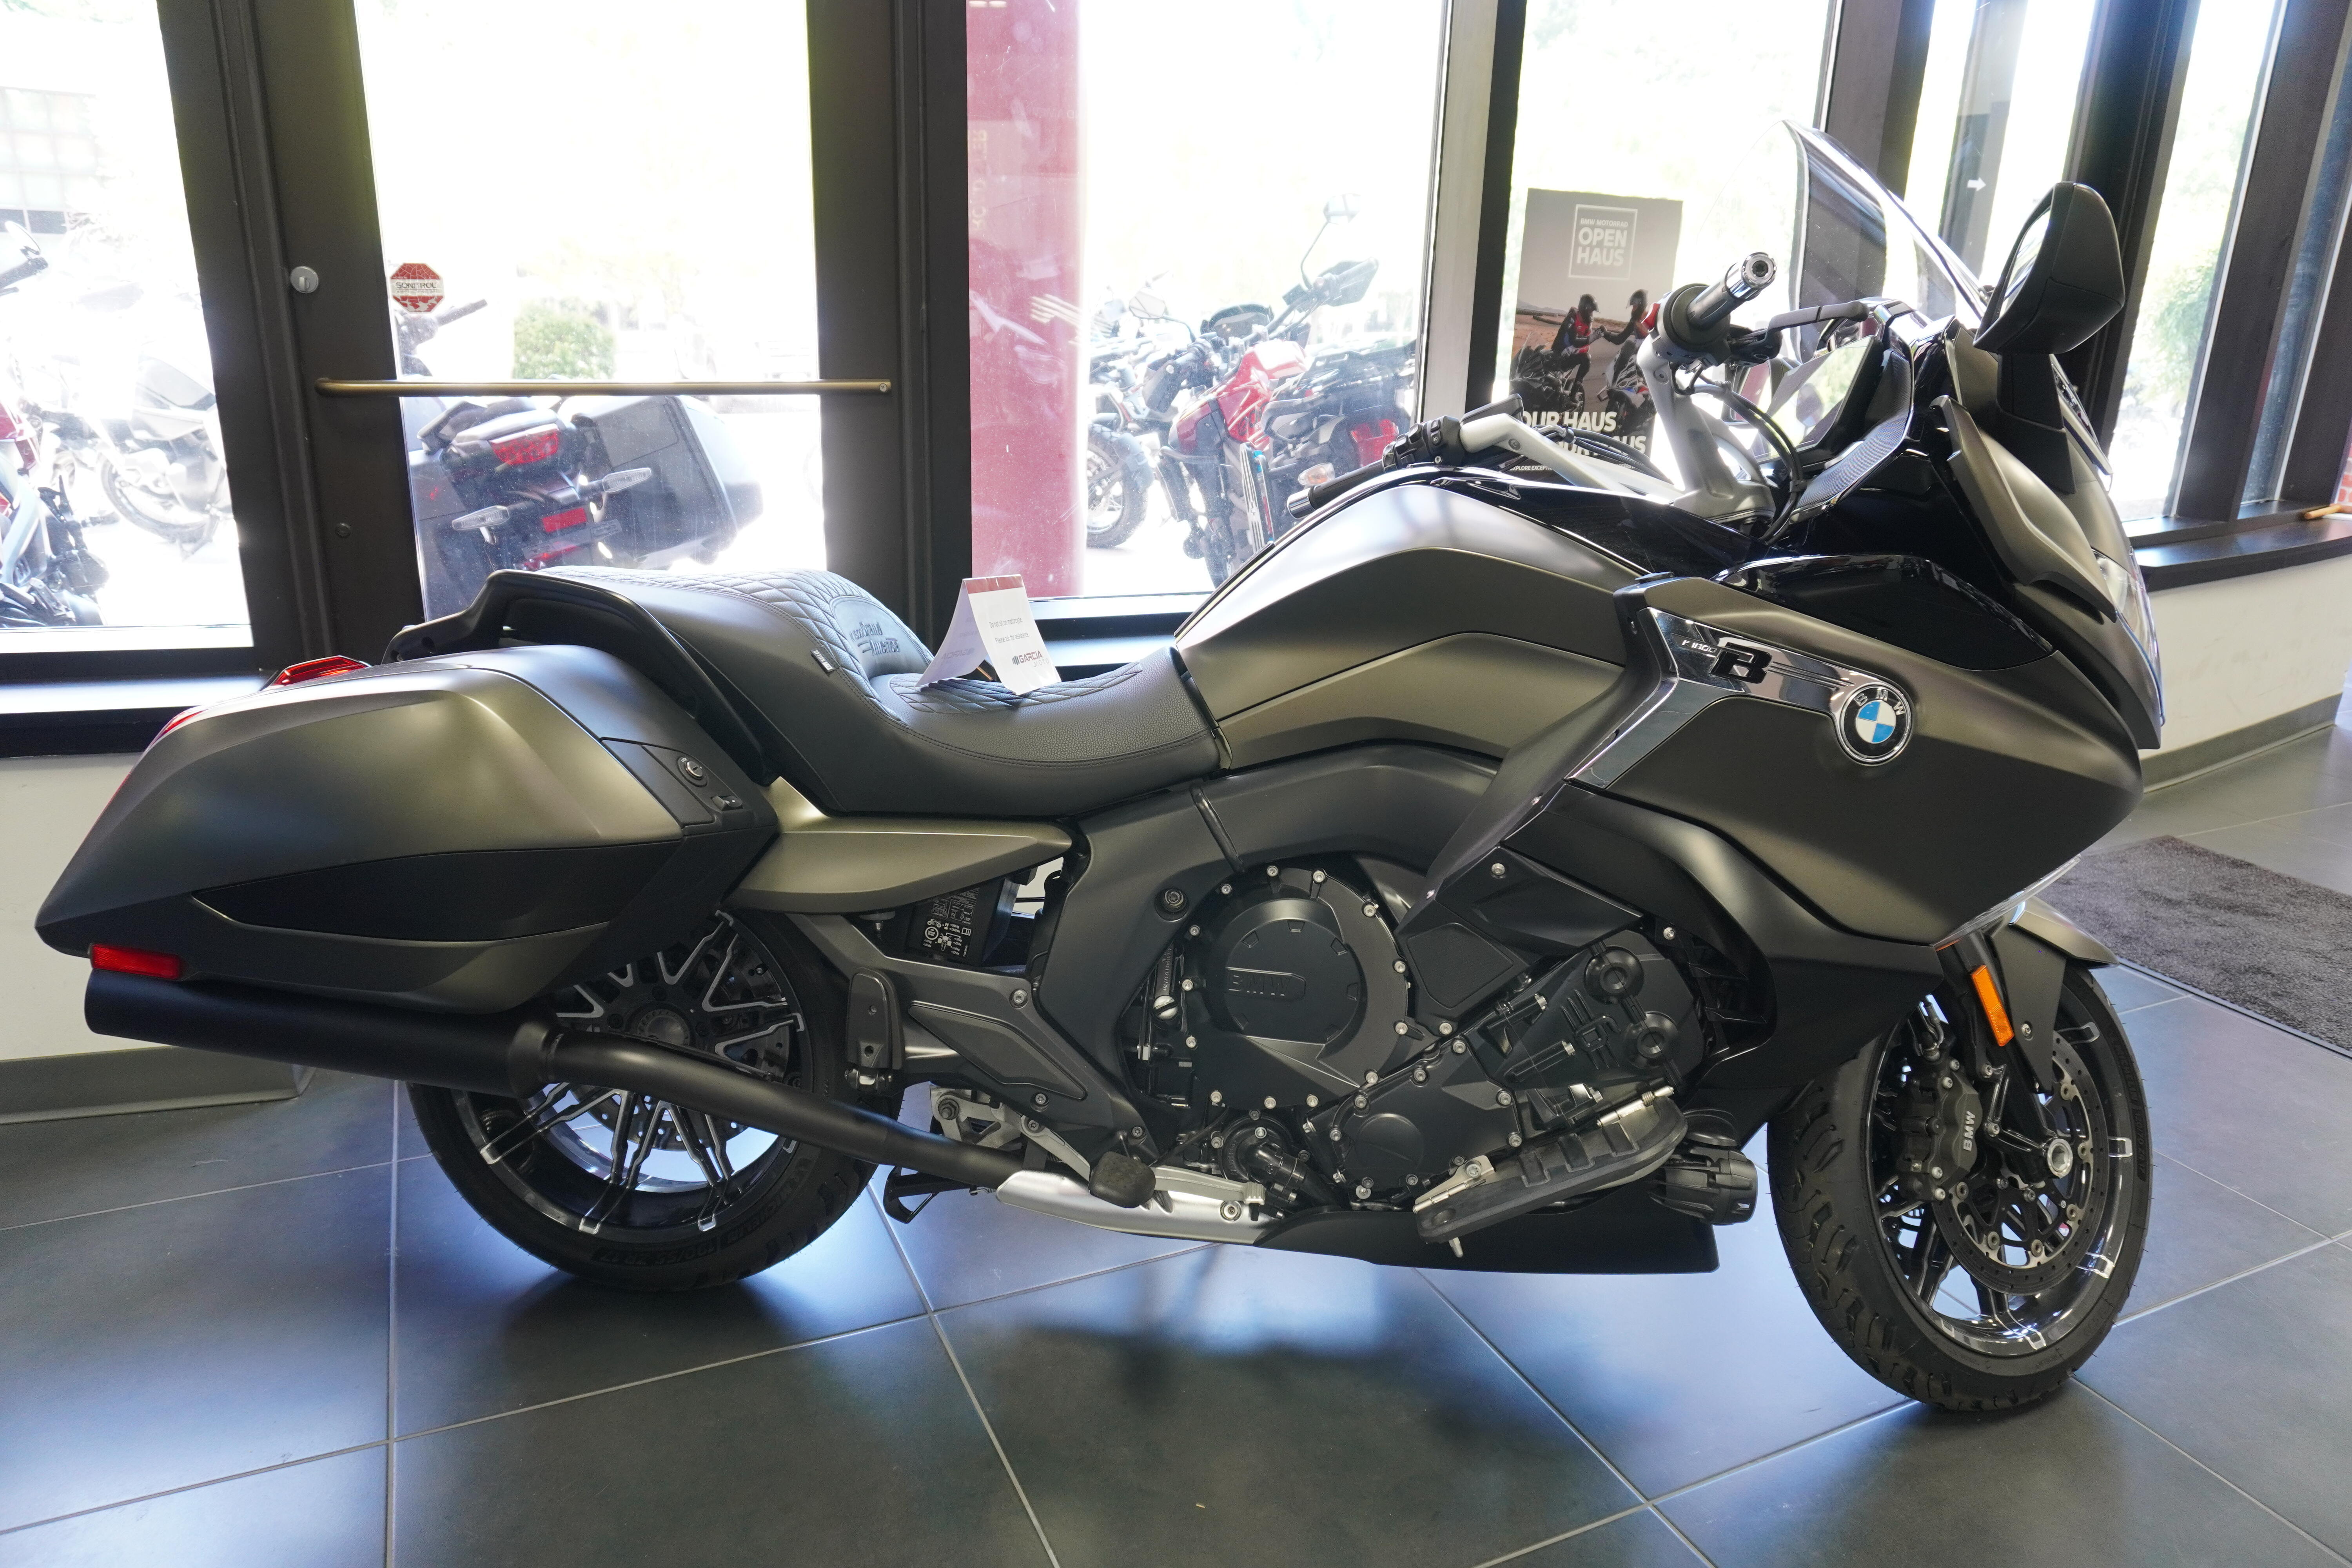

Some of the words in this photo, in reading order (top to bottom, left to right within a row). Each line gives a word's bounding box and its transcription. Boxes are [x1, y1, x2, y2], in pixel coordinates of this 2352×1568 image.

[1579, 227, 1628, 247] OPEN
[1577, 246, 1624, 266] HAUS
[1563, 411, 1617, 432] HAUS
[1019, 650, 1043, 663] GARCIA
[1033, 658, 1050, 667] MOTO
[1854, 687, 1905, 715] BMW
[1229, 975, 1292, 996] BMW
[1963, 1110, 1975, 1151] BMW
